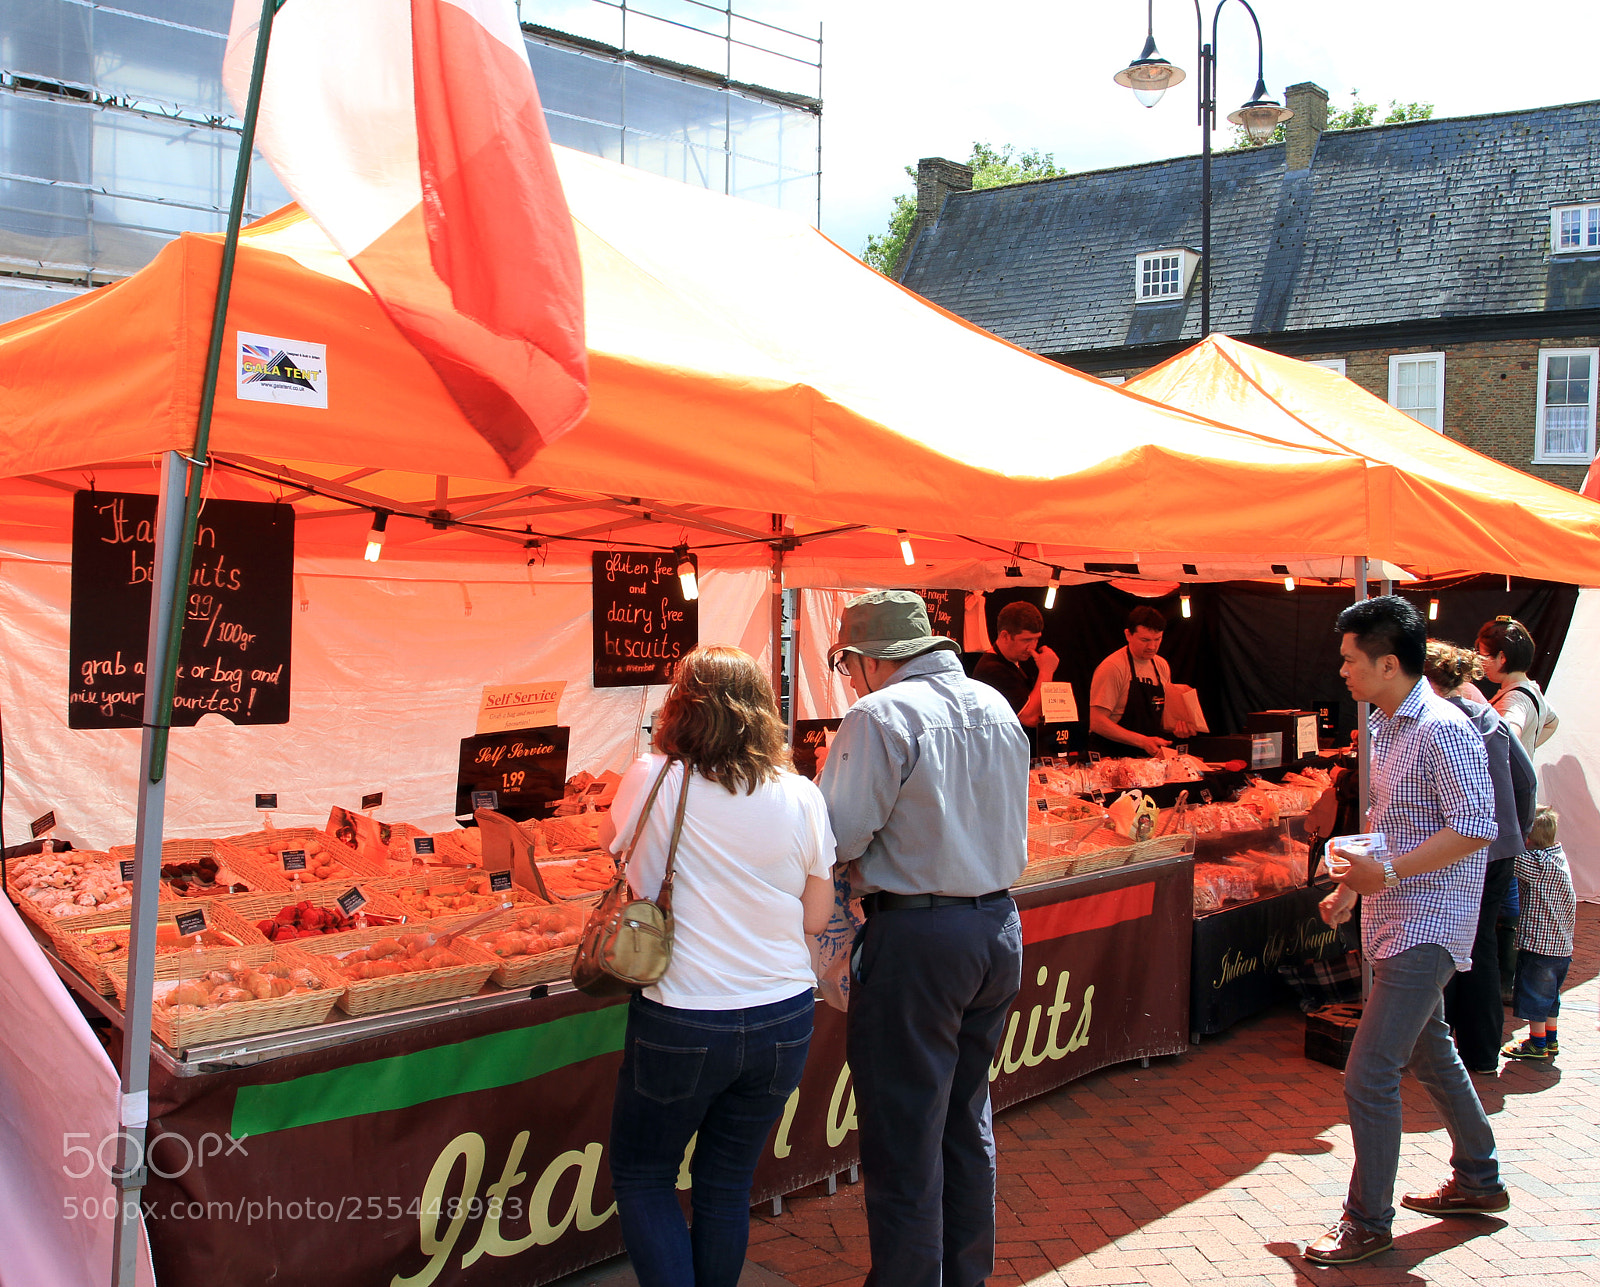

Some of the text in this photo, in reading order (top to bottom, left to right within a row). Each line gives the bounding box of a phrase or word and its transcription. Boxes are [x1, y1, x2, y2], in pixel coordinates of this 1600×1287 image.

[243, 361, 320, 381] GALA TENT
[605, 553, 674, 584] gluten free
[629, 582, 647, 594] and
[607, 597, 684, 634] dairy free
[605, 631, 681, 659] biscuits
[81, 651, 127, 685] grab
[134, 661, 145, 675] a
[191, 665, 210, 679] or
[210, 656, 243, 693] bag
[251, 664, 283, 685] and
[626, 663, 656, 673] member
[70, 689, 98, 704] mix
[101, 691, 144, 717] your
[486, 689, 557, 707] Self Service
[1056, 730, 1069, 741] 2.50
[475, 742, 555, 767] Self Service
[502, 771, 525, 788] 1.99
